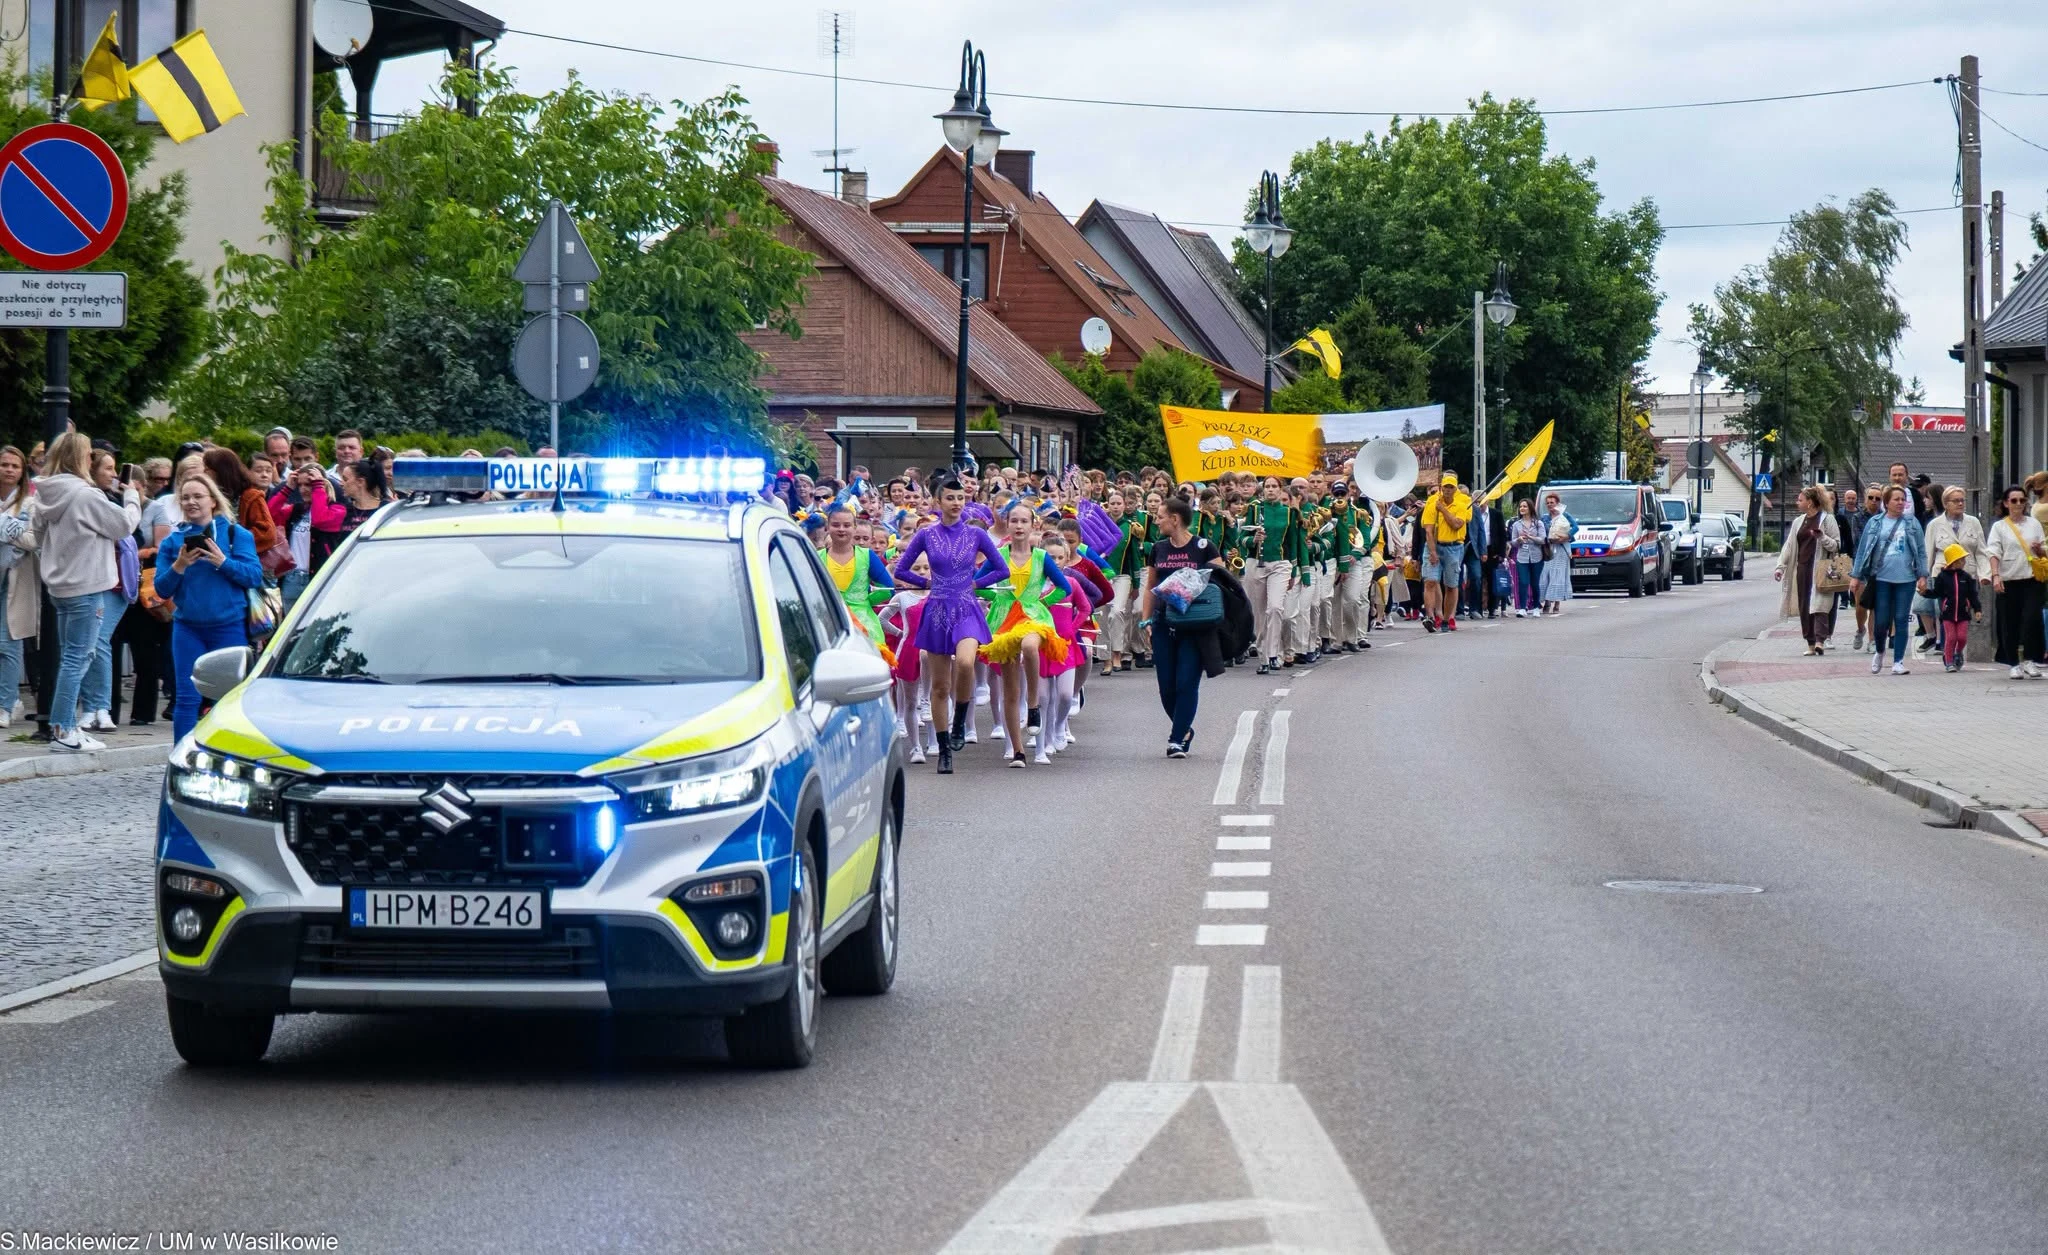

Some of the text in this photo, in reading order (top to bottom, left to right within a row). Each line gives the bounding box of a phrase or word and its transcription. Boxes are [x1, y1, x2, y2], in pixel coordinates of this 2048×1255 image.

[22, 280, 87, 292] Nie dotyczy
[0, 293, 123, 307] eszkańców przyległych
[5, 308, 102, 319] posesji do 5 min
[1922, 417, 1966, 432] Chorte
[1202, 456, 1236, 471] KLUB
[490, 463, 584, 489] POLICJA
[338, 715, 583, 737] POLICJA
[353, 894, 533, 927] PL HPM B246
